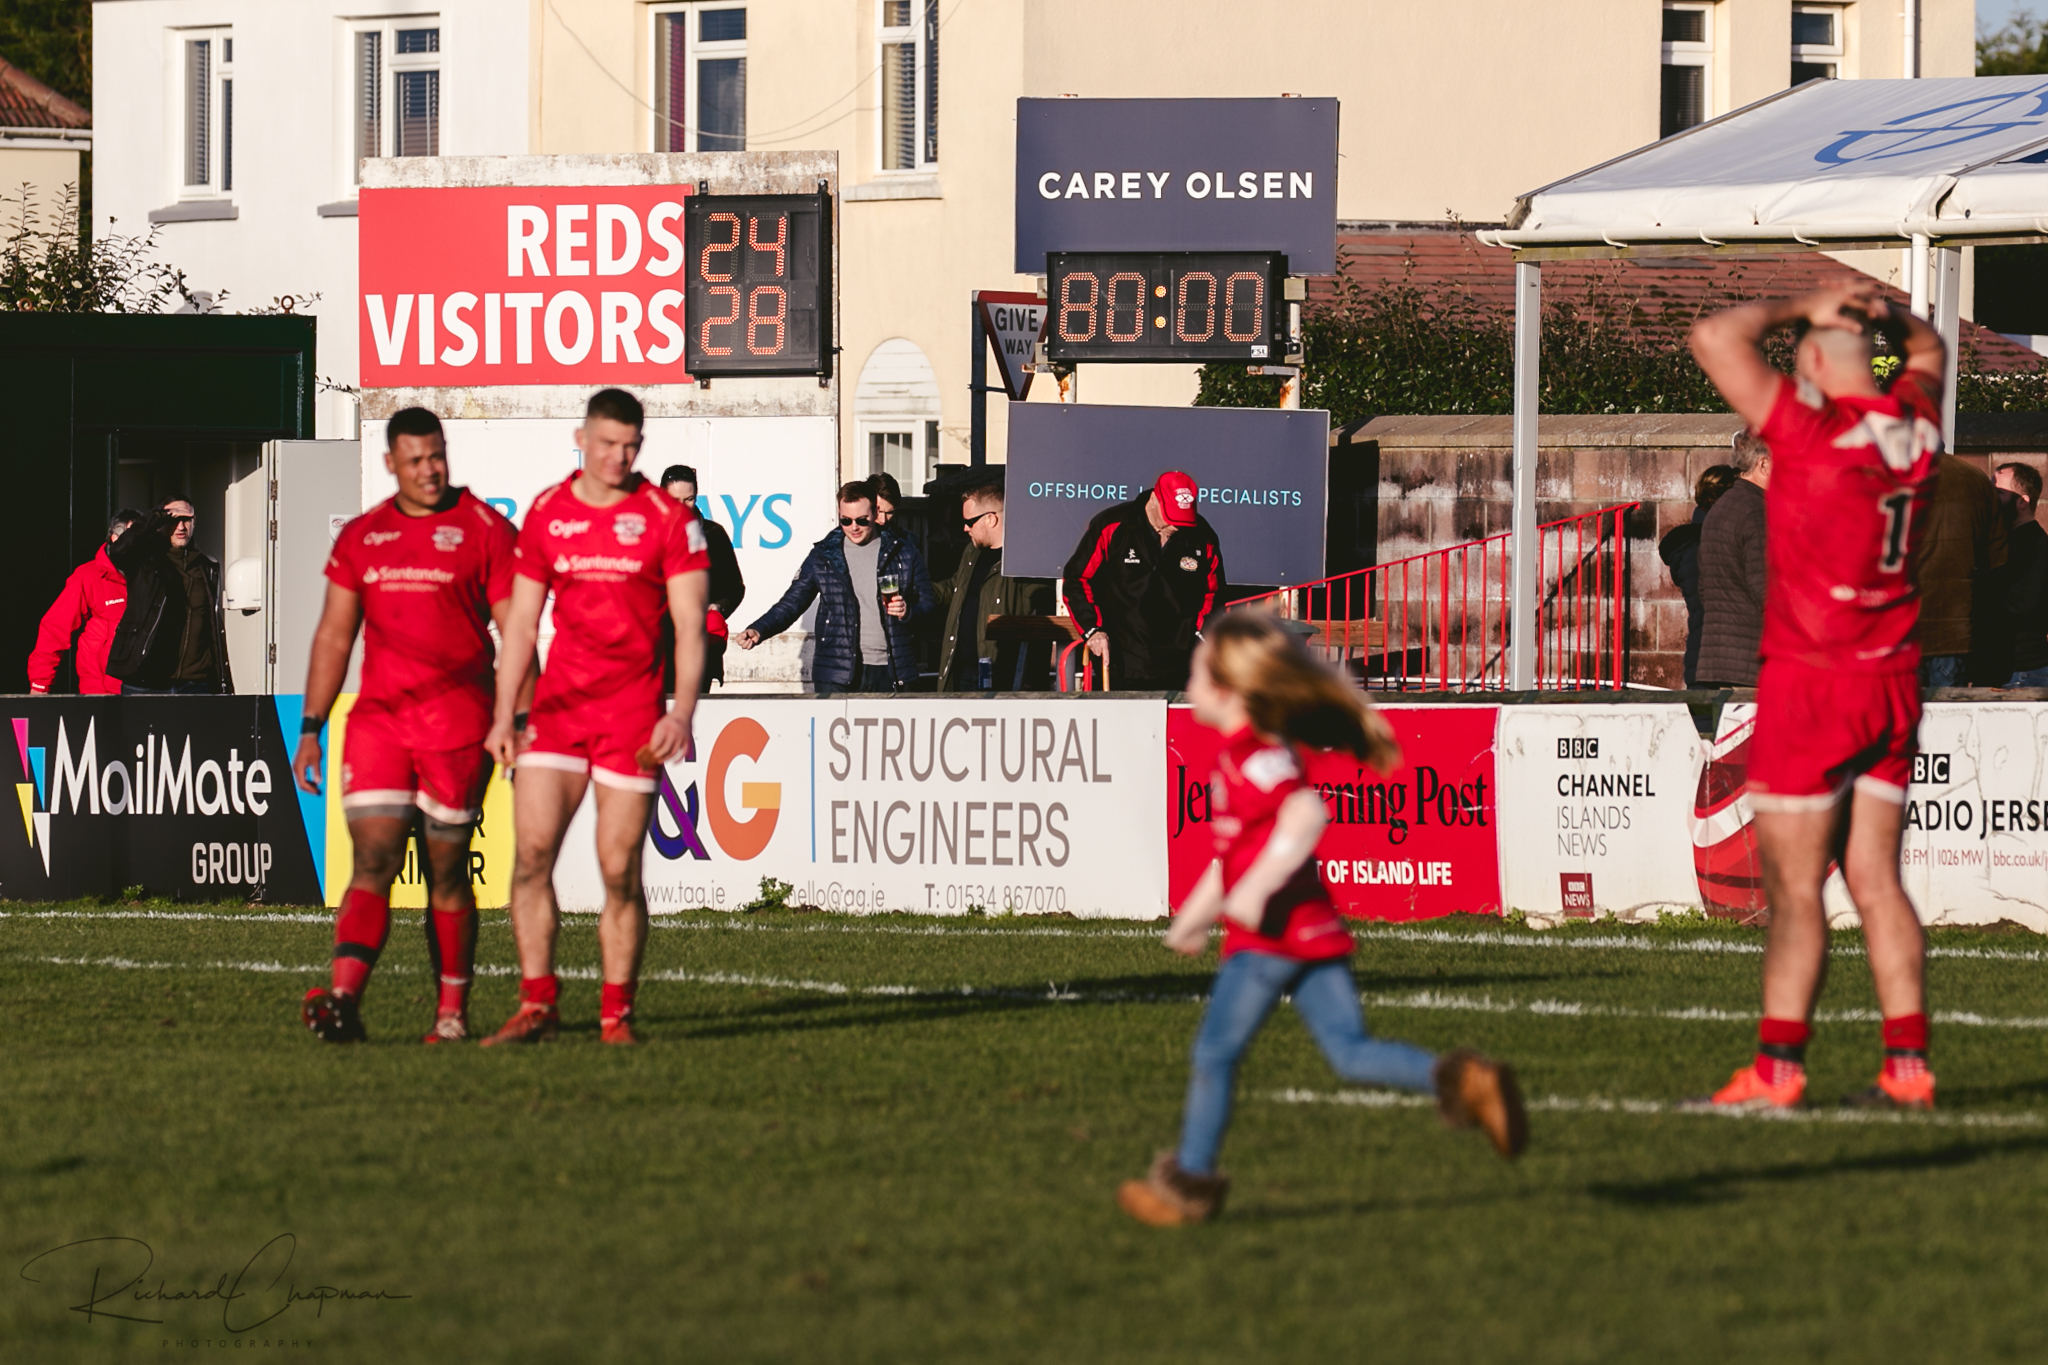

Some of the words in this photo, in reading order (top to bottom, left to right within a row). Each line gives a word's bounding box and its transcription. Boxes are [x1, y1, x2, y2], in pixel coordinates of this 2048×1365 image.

[1037, 172, 1171, 200] CAREY
[1185, 172, 1313, 200] OLSEN
[507, 201, 685, 277] REDS
[700, 212, 787, 283] 24
[700, 285, 787, 355] 28
[994, 308, 1039, 333] GIVE
[1058, 271, 1264, 342] 80:00
[365, 289, 685, 366] VISITORS
[1004, 339, 1033, 356] WAY
[1029, 482, 1129, 501] OFFSHORE
[1197, 487, 1302, 506] PECIALISTS
[828, 717, 1112, 783] STRUCTURAL
[1558, 738, 1599, 759] BBC
[50, 715, 272, 816] MailMate
[1911, 754, 1950, 784] BC
[1557, 773, 1656, 797] CHANNEL
[1172, 765, 1215, 839] Jer
[1414, 765, 1489, 827] Post
[1903, 799, 1973, 832] ADIO
[1557, 805, 1631, 829] ISLANDS
[831, 800, 1070, 868] ENGINEERS
[1558, 833, 1607, 857] NEWS
[192, 842, 272, 885] GROUP
[1326, 859, 1350, 884] OF
[1352, 860, 1415, 886] ISLAND
[1417, 861, 1453, 886] LIFE
[1913, 849, 1928, 866] FM
[1961, 850, 1984, 867] MW
[946, 884, 997, 910] 01534
[1002, 885, 1066, 911] 867070
[1564, 893, 1591, 907] NEWS
